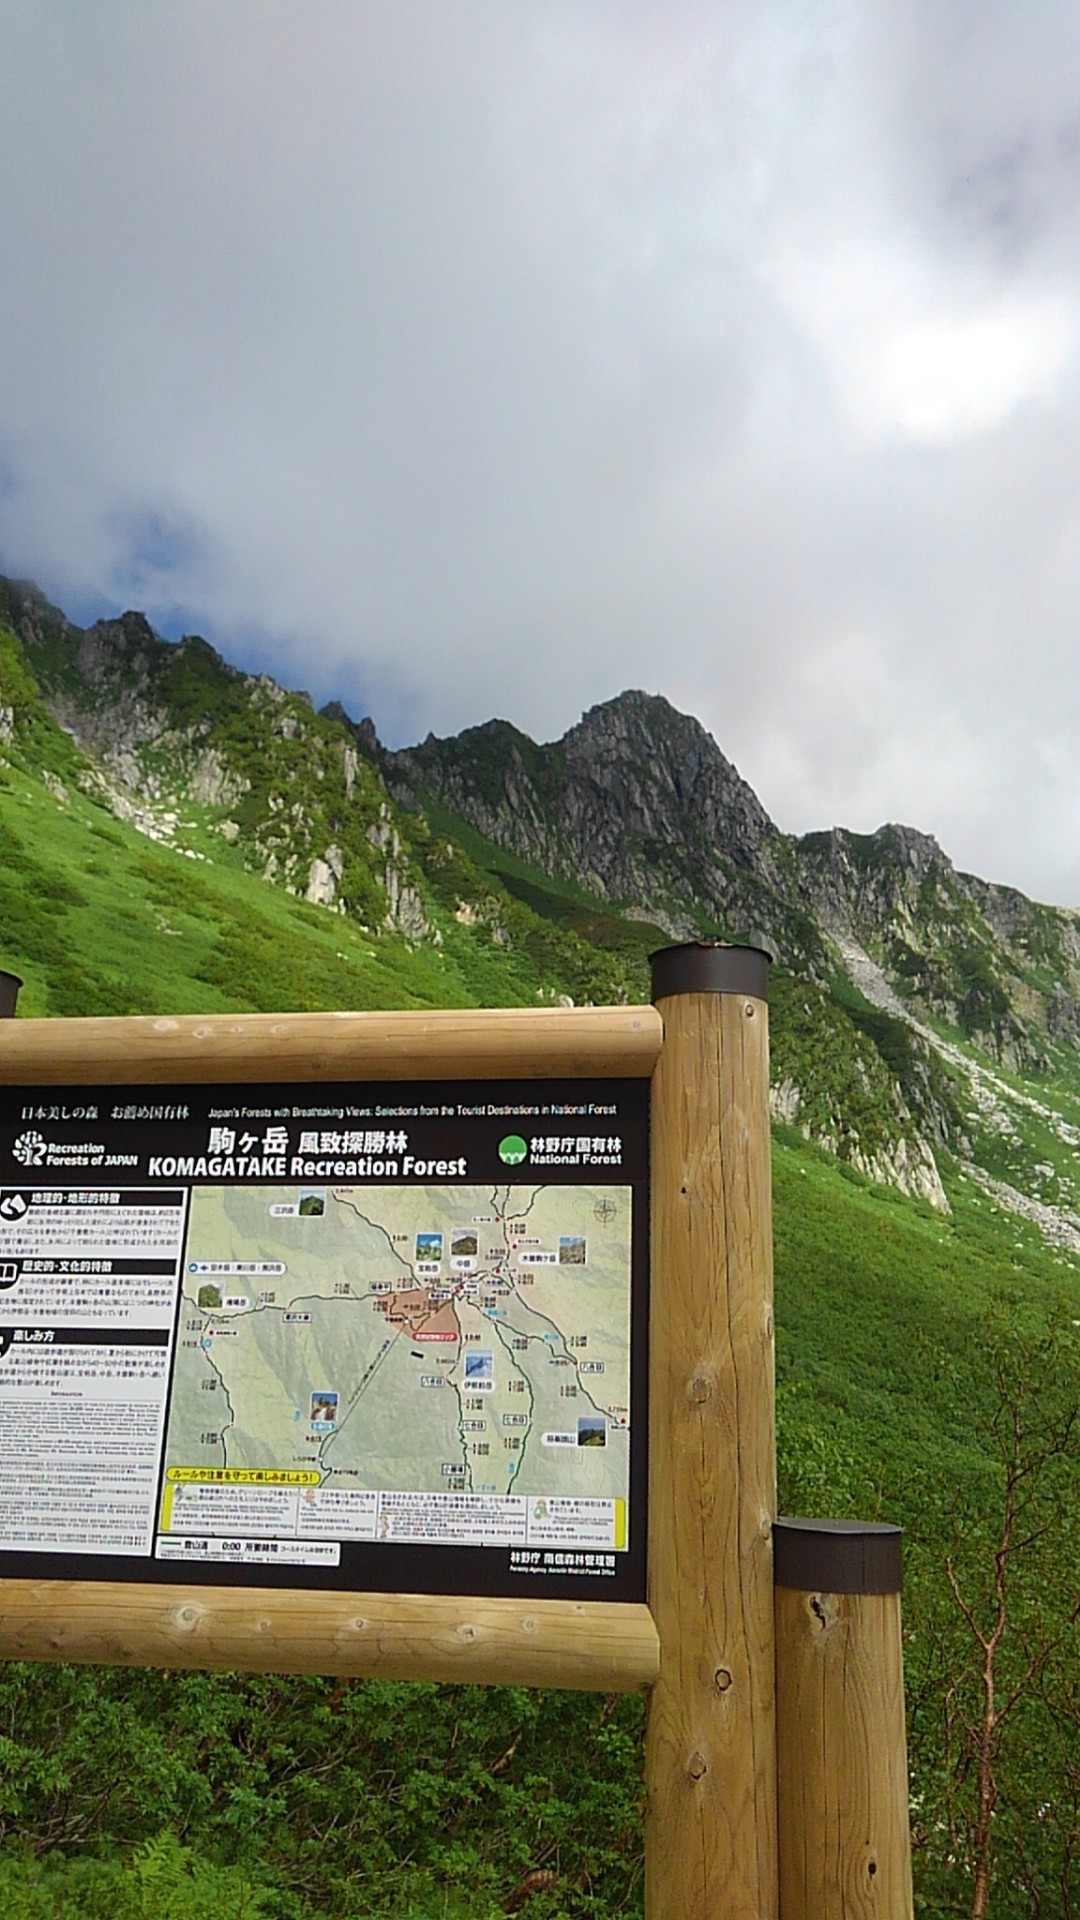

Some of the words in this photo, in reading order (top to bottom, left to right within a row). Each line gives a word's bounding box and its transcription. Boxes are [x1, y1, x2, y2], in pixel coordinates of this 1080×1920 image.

[208, 1107, 240, 1120] Japan's
[241, 1107, 272, 1118] Forests
[274, 1107, 290, 1117] with
[292, 1106, 344, 1119] Breathtaking
[375, 1105, 418, 1117] Selections
[420, 1105, 439, 1116] from
[441, 1105, 454, 1116] the
[457, 1104, 486, 1115] Tourist
[487, 1104, 539, 1115] Destinations
[541, 1104, 549, 1115] in
[551, 1104, 587, 1115] National
[588, 1103, 617, 1115] Forest
[48, 1142, 105, 1154] Recreation
[298, 1130, 408, 1155] 風致探勝林
[530, 1136, 622, 1153] 林野庁国有林
[46, 1155, 89, 1166] Forests
[91, 1154, 103, 1166] of
[104, 1155, 138, 1166] JAPAN
[148, 1156, 287, 1177] KOMAGATAKE
[290, 1155, 398, 1176] Recreation
[402, 1155, 467, 1176] Forest
[530, 1153, 580, 1165] National
[582, 1153, 622, 1165] Forest
[221, 1541, 242, 1552] 0:00
